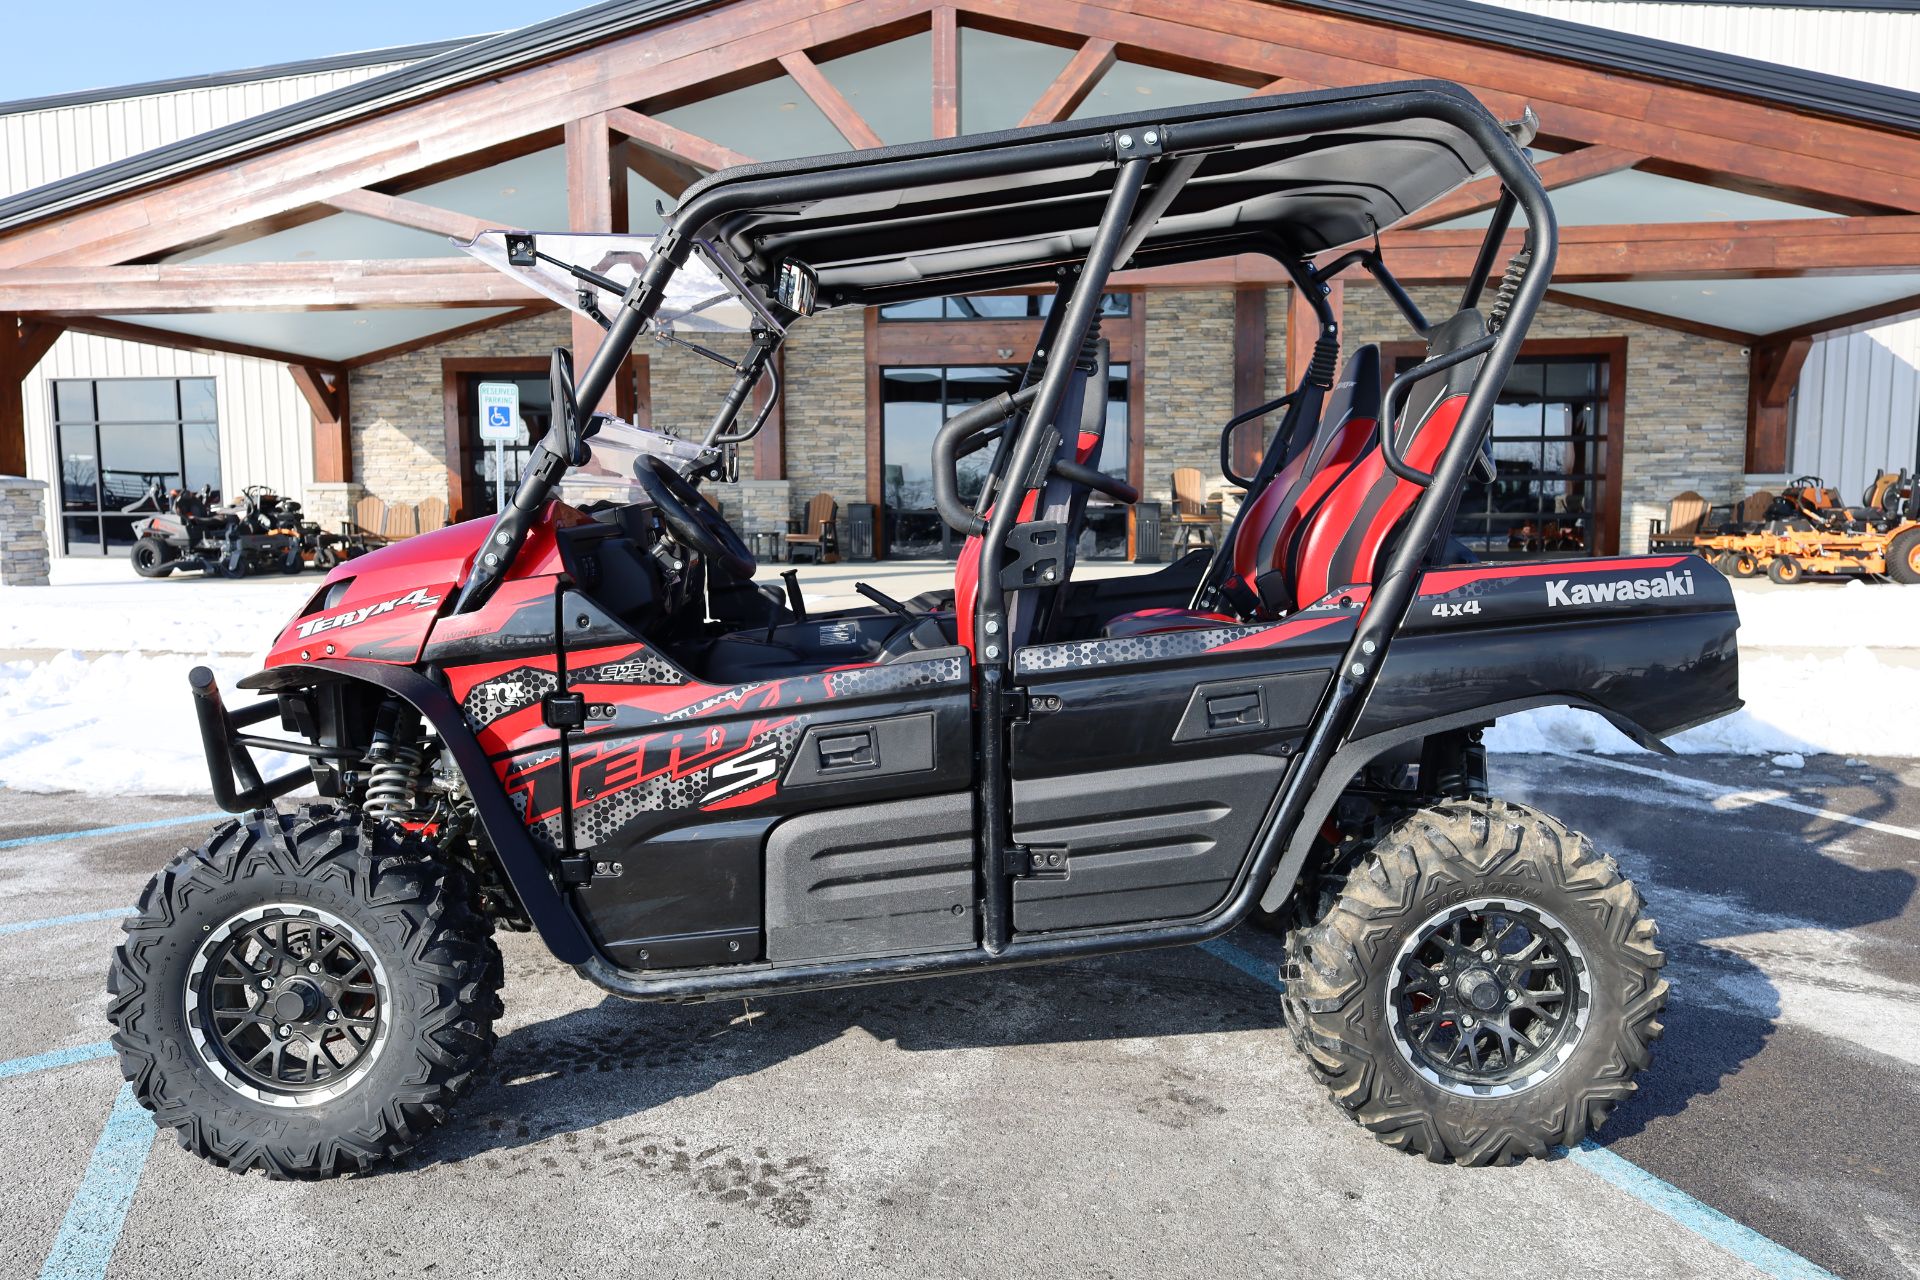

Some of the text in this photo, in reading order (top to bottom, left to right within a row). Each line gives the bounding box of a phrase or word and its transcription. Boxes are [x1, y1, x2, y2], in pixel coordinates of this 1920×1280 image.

[480, 387, 516, 396] RESERVED
[485, 395, 513, 404] PARKING
[1545, 569, 1696, 607] Kawasaki
[1431, 600, 1482, 618] 4x4
[601, 663, 645, 679] EPS
[485, 682, 525, 705] FOX
[1424, 880, 1543, 916] BIGHORN
